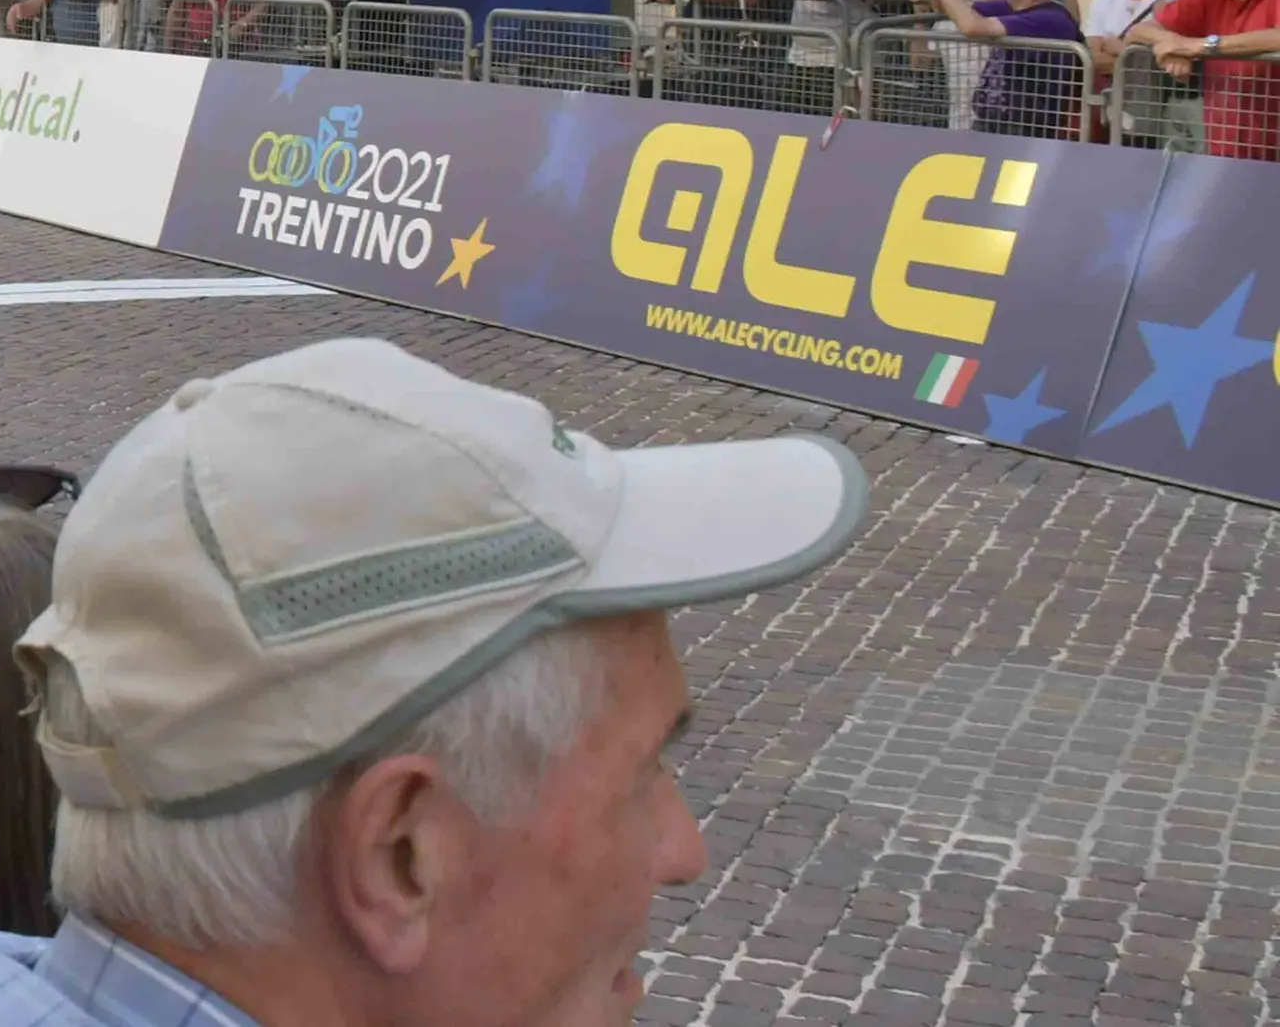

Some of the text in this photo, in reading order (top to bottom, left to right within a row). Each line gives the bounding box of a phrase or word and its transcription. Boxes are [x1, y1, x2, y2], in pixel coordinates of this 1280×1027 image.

[356, 143, 451, 214] 2021
[236, 186, 433, 272] TRENTINO
[645, 303, 904, 379] WWW.ALECYCLING.COM
